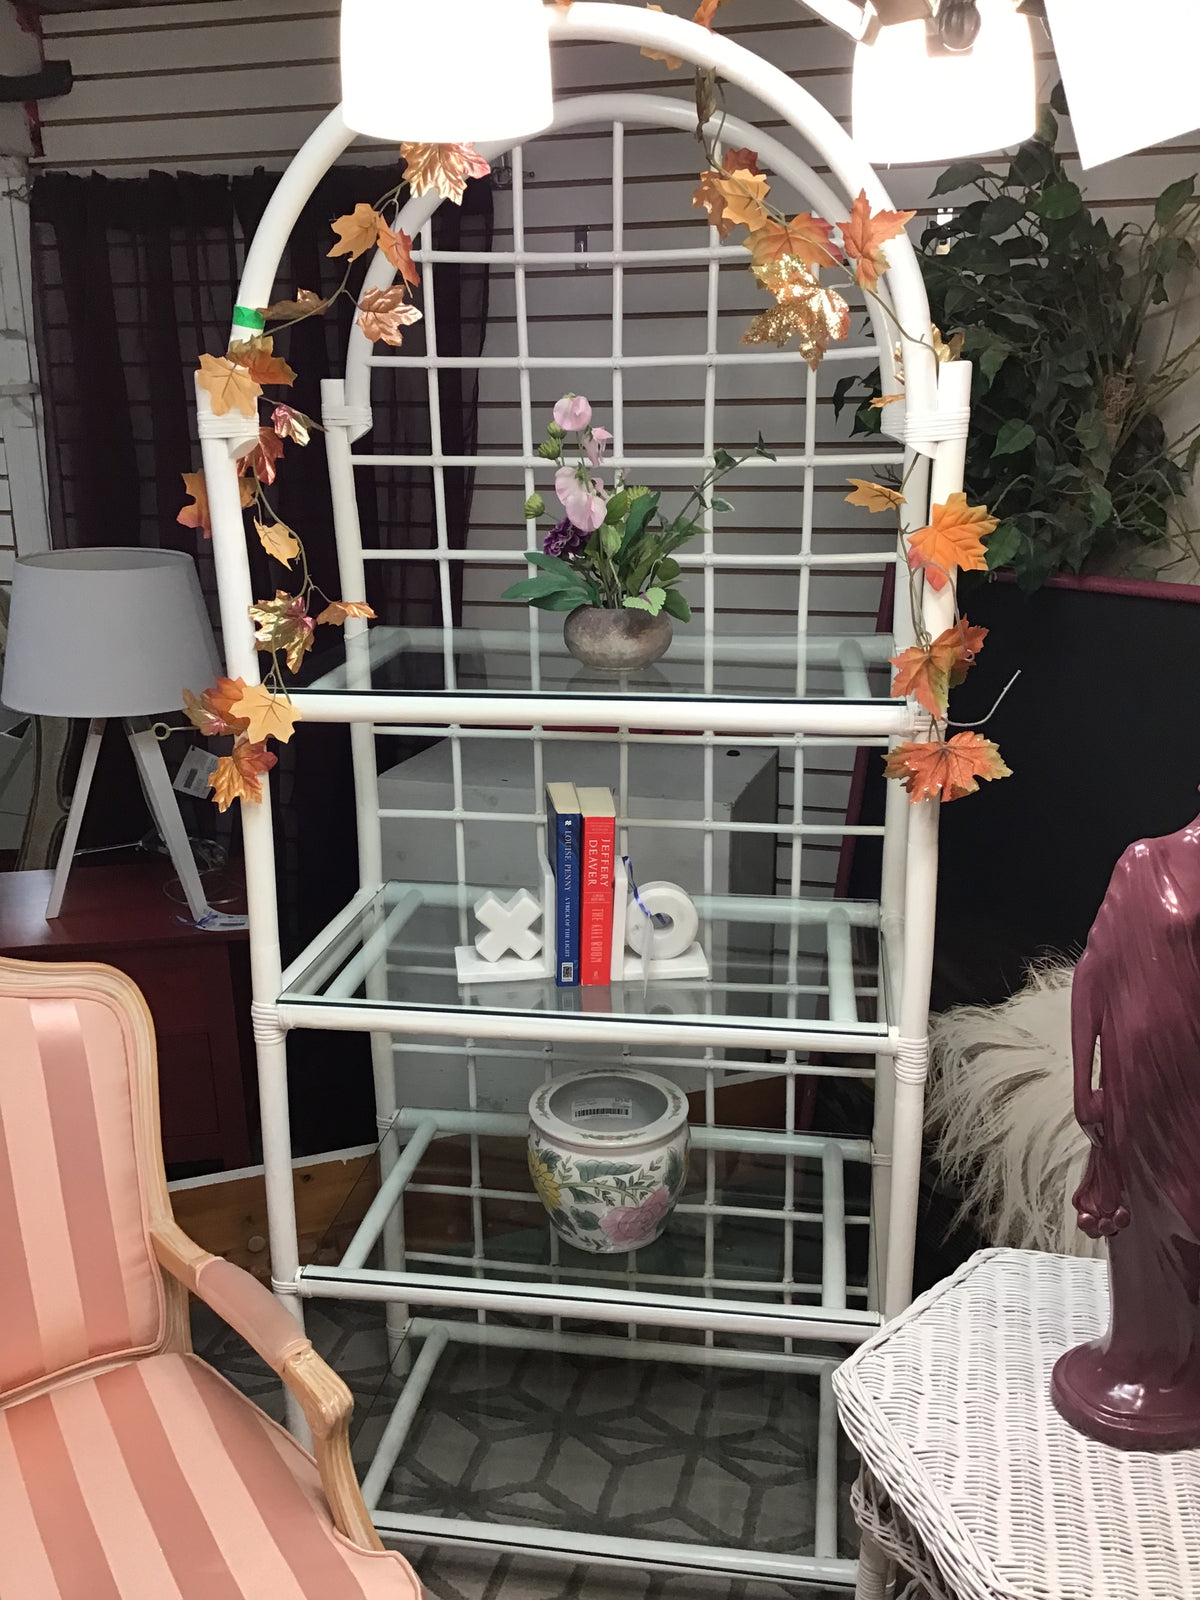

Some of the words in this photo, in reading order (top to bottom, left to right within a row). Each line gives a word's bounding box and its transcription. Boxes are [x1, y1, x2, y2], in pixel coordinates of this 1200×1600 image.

[564, 830, 572, 862] LOUISE
[588, 840, 598, 886] DEAVER
[600, 838, 611, 887] JEFFERY
[564, 864, 572, 891] PENNY
[592, 908, 604, 922] THE
[591, 924, 603, 939] KILL
[590, 941, 603, 963] ROOM
